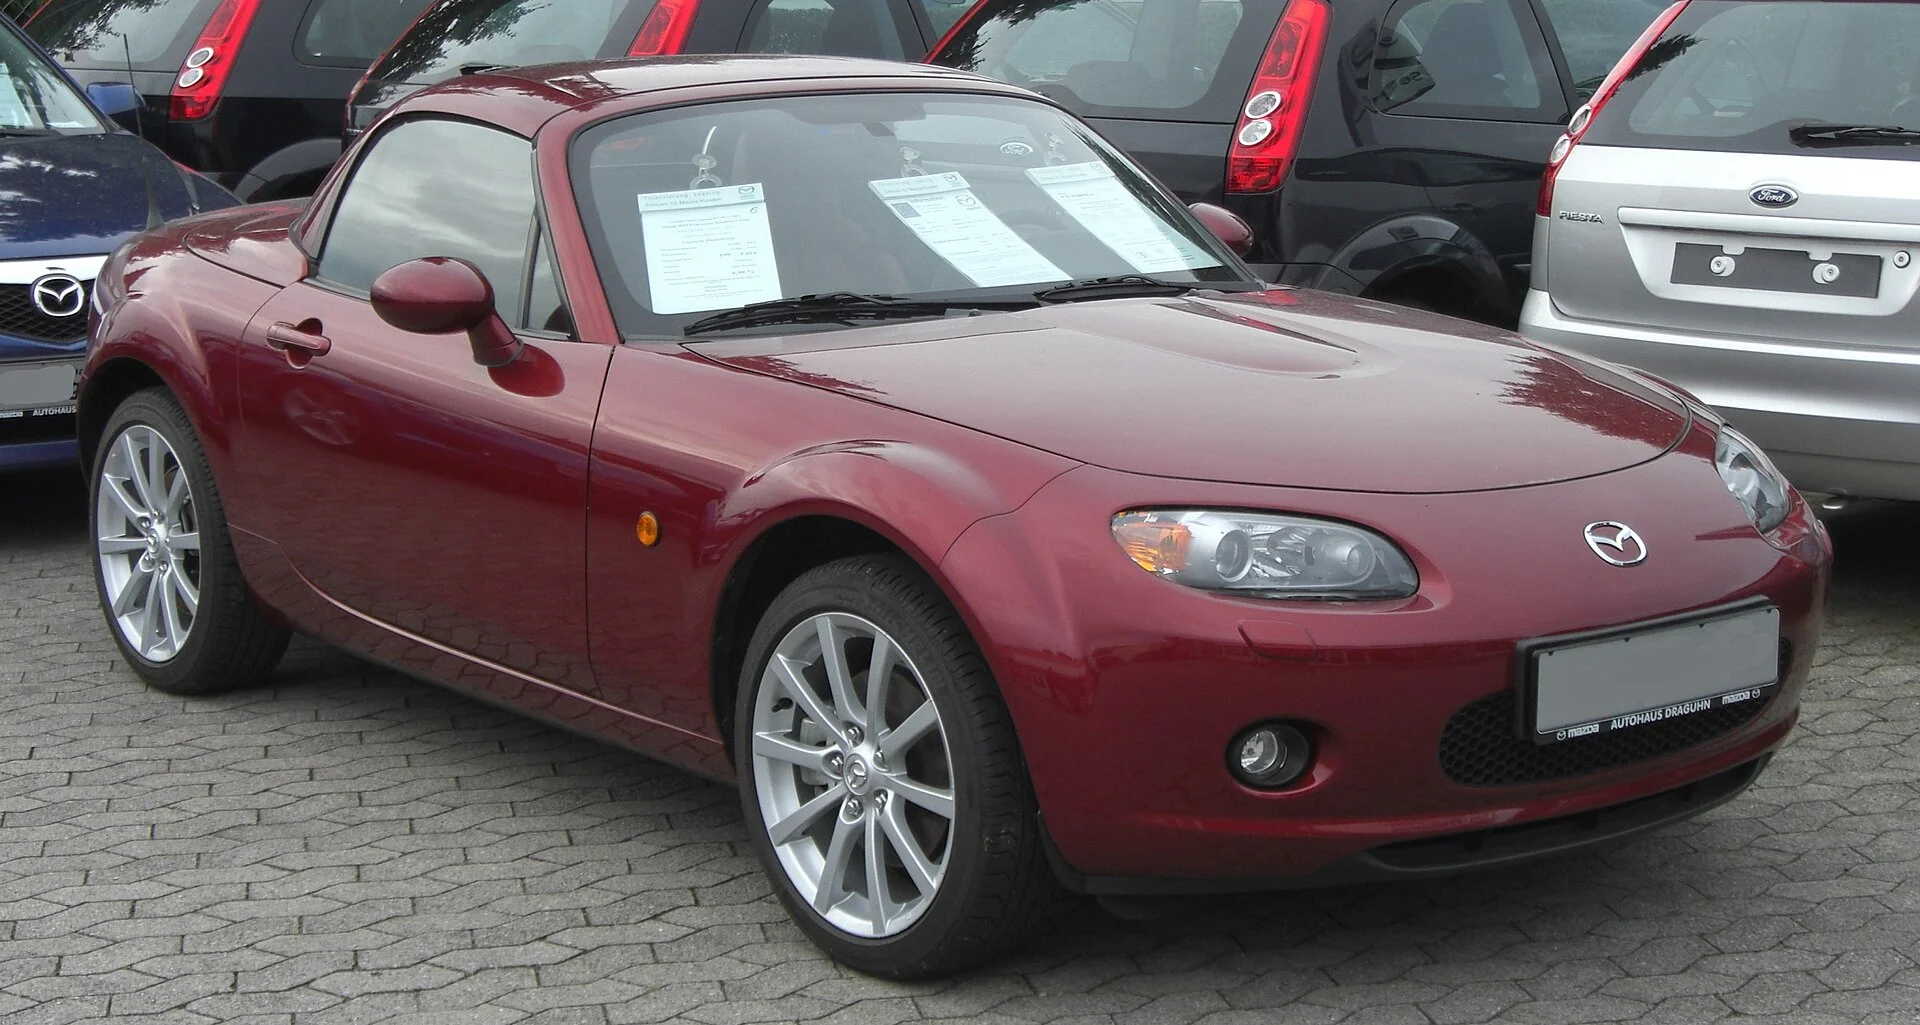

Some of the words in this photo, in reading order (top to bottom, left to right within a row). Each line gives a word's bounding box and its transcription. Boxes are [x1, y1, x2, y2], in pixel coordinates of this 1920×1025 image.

[1559, 211, 1604, 224] FIESTA
[32, 405, 77, 417] AUTOHAUS
[1568, 723, 1600, 738] mazda
[1610, 709, 1663, 730] AUTOHAUS
[1665, 699, 1711, 719] DRAGUHN
[1721, 690, 1750, 705] mazda
